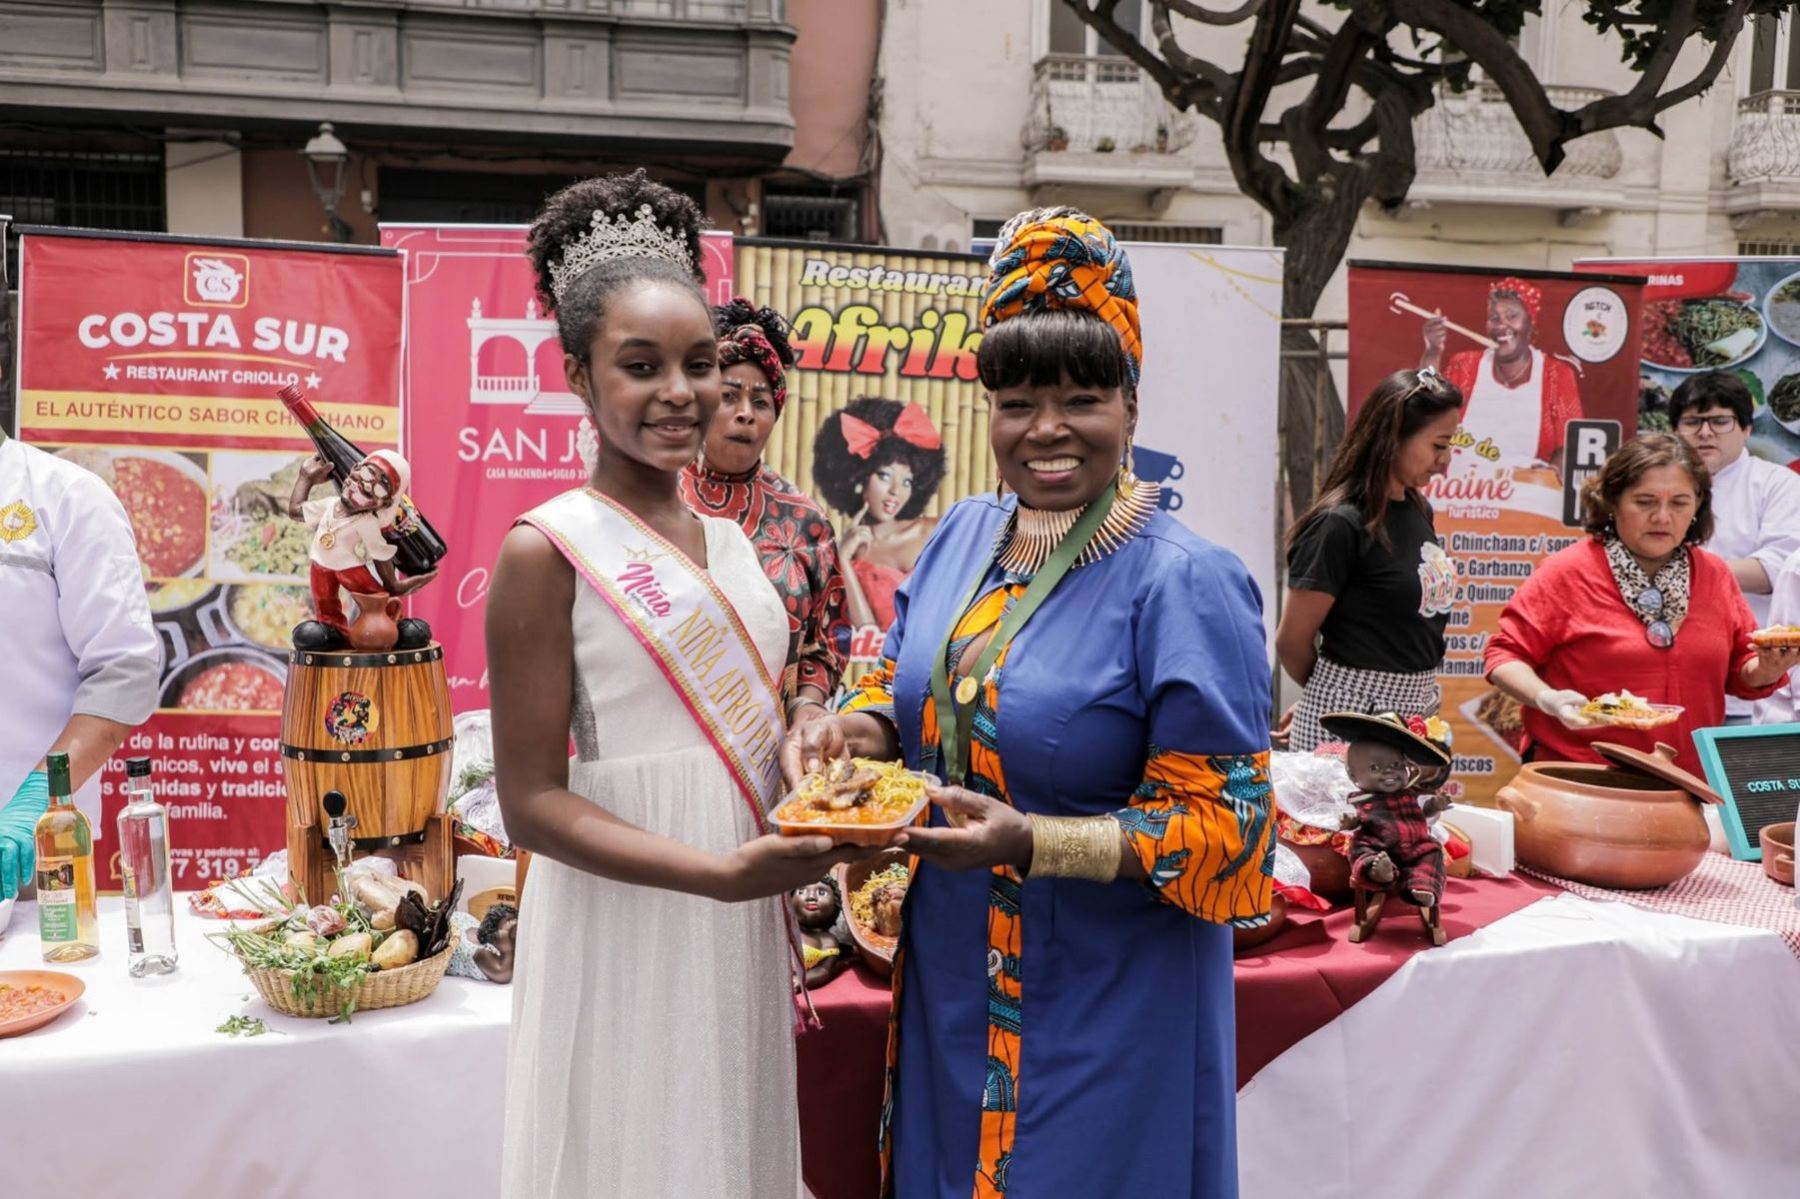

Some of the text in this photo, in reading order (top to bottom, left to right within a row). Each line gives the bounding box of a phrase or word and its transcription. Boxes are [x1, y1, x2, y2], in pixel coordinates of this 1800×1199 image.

[800, 259, 987, 298] Restauran
[1648, 274, 1684, 286] RINAS
[78, 312, 350, 362] COSTA SUR
[787, 305, 984, 381] Afrik
[126, 365, 299, 386] RESTAURANT CRIOLLO
[36, 399, 385, 431] EL AUTÉNTICO SABOR CHHANO
[458, 427, 547, 462] SAN
[1476, 437, 1500, 461] de
[1577, 427, 1607, 465] R
[486, 468, 506, 479] CASA
[508, 468, 547, 480] HACIENDA
[1453, 534, 1526, 552] Chinchana
[1469, 559, 1532, 577] Garbanzo
[617, 560, 672, 618] Niña
[1467, 585, 1516, 602] Quinua
[668, 607, 727, 682] NIÑA
[703, 667, 762, 736] AFRO
[130, 733, 152, 750] de
[158, 733, 173, 750] la
[179, 734, 229, 750] rutina
[234, 738, 245, 754] y
[151, 757, 204, 775] nicos,
[210, 757, 248, 773] vive
[253, 758, 269, 774] el
[1453, 757, 1493, 772] iscos
[119, 779, 201, 796] cmidas
[207, 783, 217, 799] y
[1747, 778, 1800, 793] COSTA SU
[166, 802, 228, 820] familia.
[196, 858, 239, 879] 319
